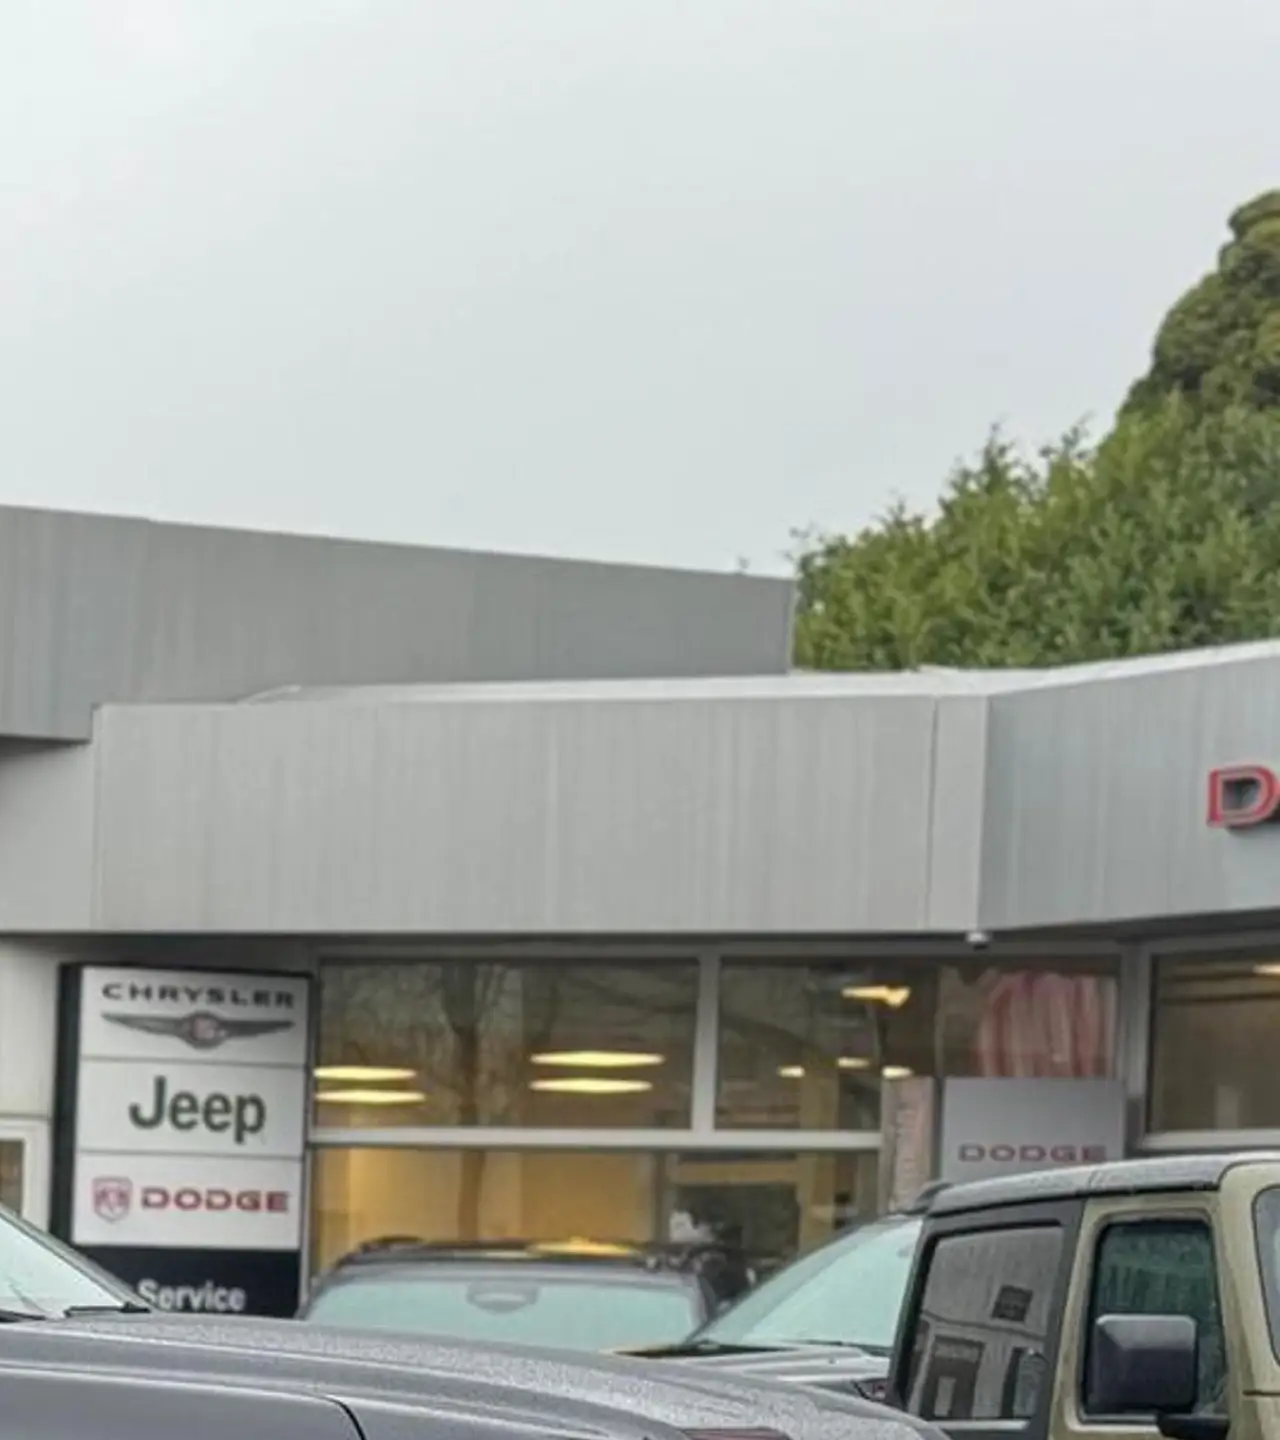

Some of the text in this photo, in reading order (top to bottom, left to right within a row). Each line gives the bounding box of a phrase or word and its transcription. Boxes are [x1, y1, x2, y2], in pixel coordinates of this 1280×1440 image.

[101, 982, 294, 1009] CHRYSLER
[128, 1075, 267, 1144] Jeep
[958, 1143, 1107, 1163] DODGE
[141, 1186, 289, 1213] DODGE
[137, 1278, 246, 1311] Service
